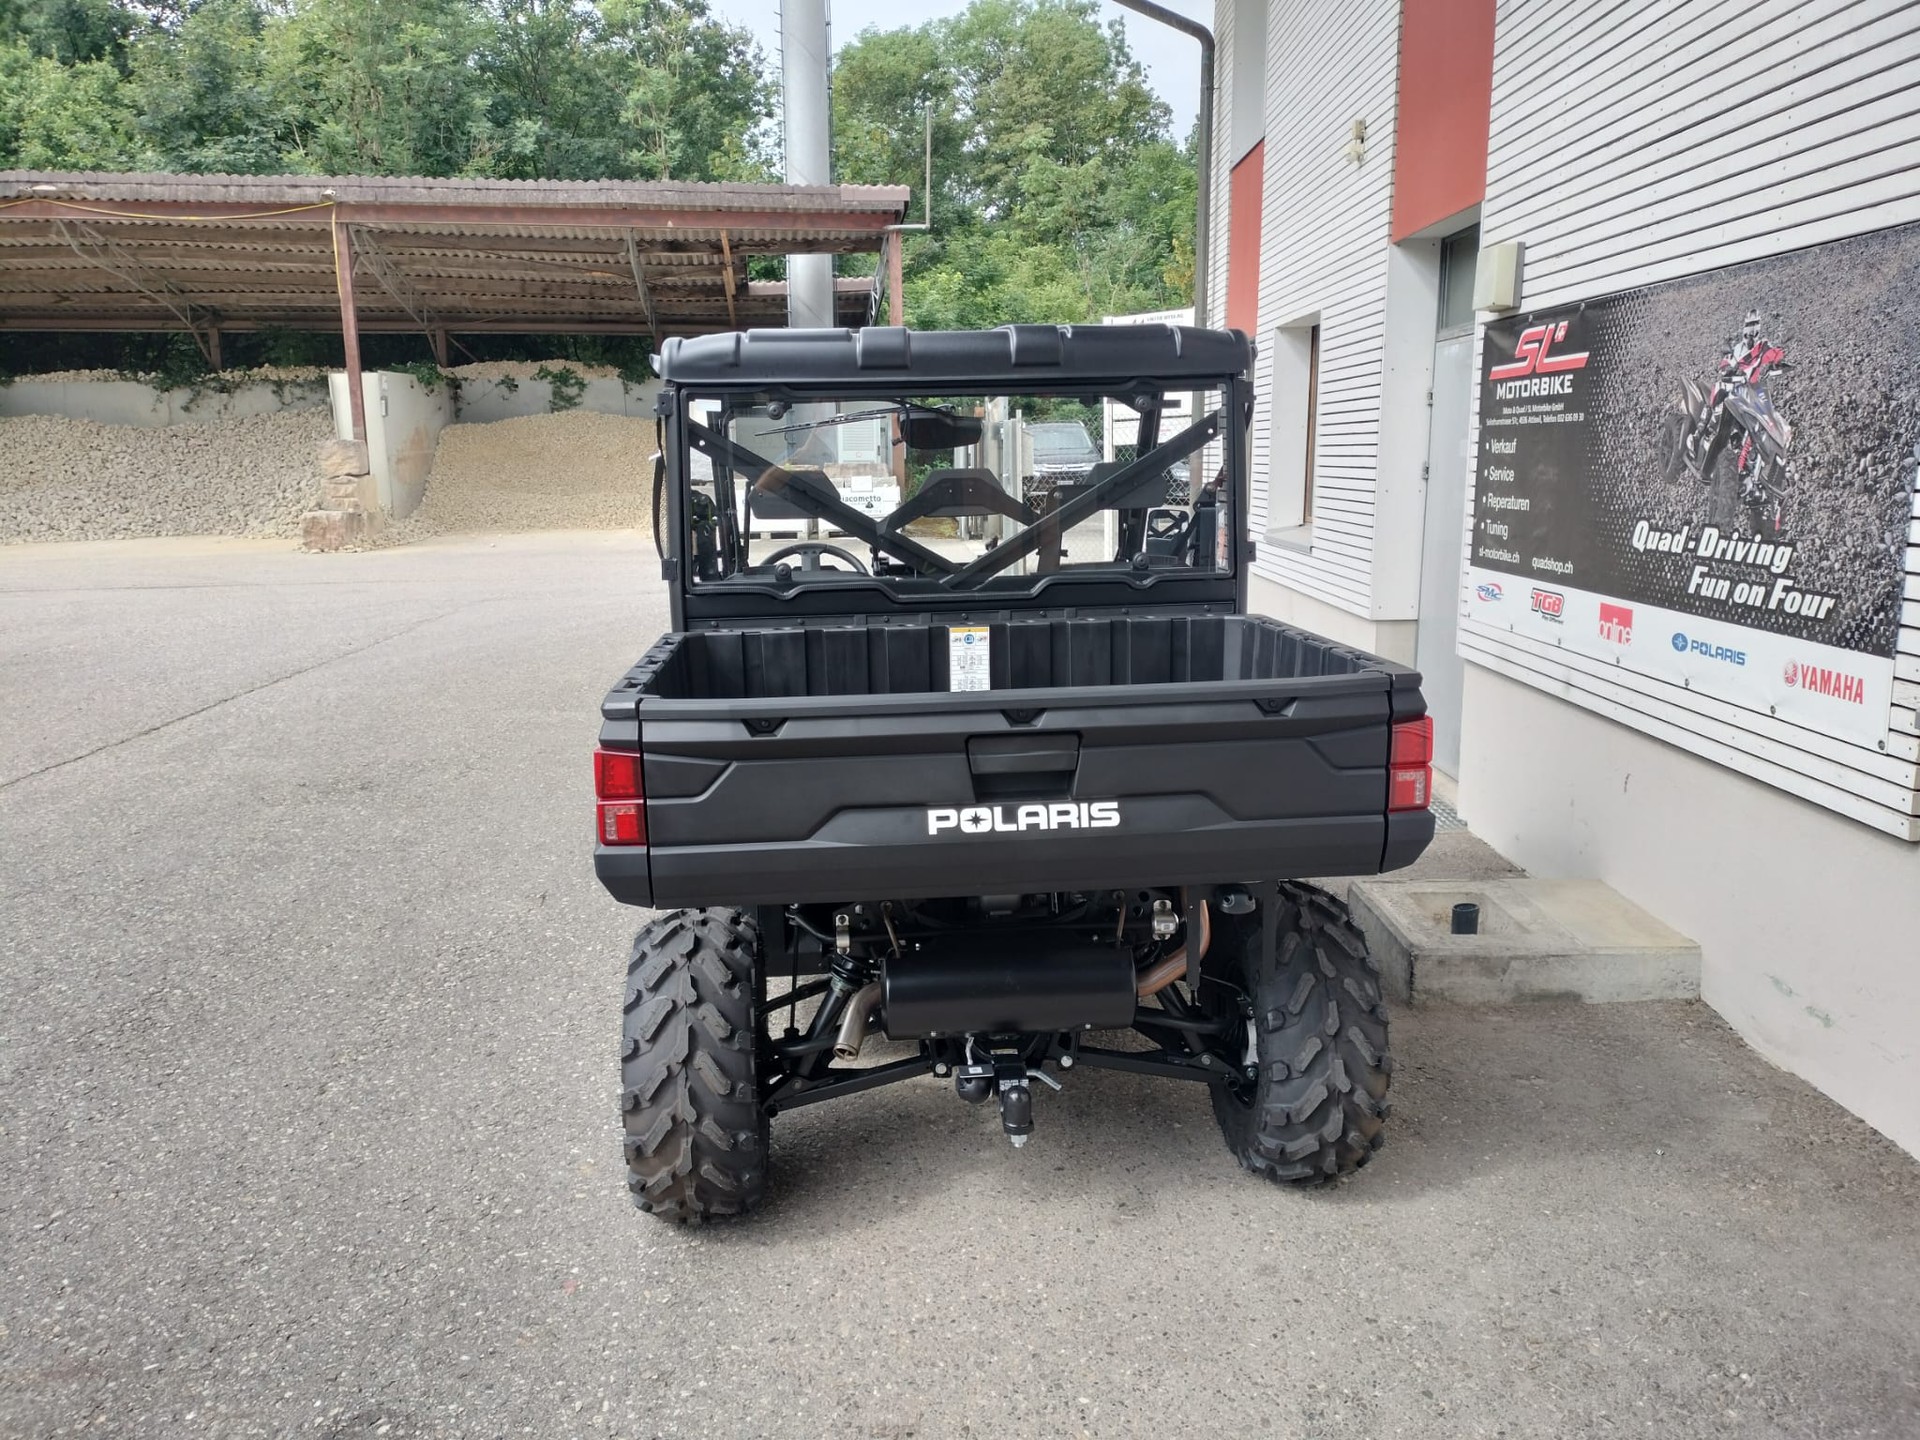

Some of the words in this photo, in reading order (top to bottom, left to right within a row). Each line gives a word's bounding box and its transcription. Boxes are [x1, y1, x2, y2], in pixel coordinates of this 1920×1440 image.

[1496, 374, 1574, 400] MOTORBIKE
[1491, 438, 1517, 454] Verkauf
[1489, 466, 1515, 482] Service
[840, 495, 882, 503] iacometto
[1487, 493, 1530, 511] Reperaturen
[1486, 519, 1509, 540] Tuning
[1479, 545, 1520, 563] sl-motorbike.ch
[1532, 556, 1574, 574] quadshop.ch
[1531, 589, 1563, 616] TGB
[1688, 565, 1731, 601] Fun
[1733, 582, 1766, 608] on
[1768, 578, 1837, 620] Four
[1690, 640, 1746, 666] POLARIS
[1801, 664, 1864, 704] YAMAHA
[927, 801, 1121, 836] POLARIS
